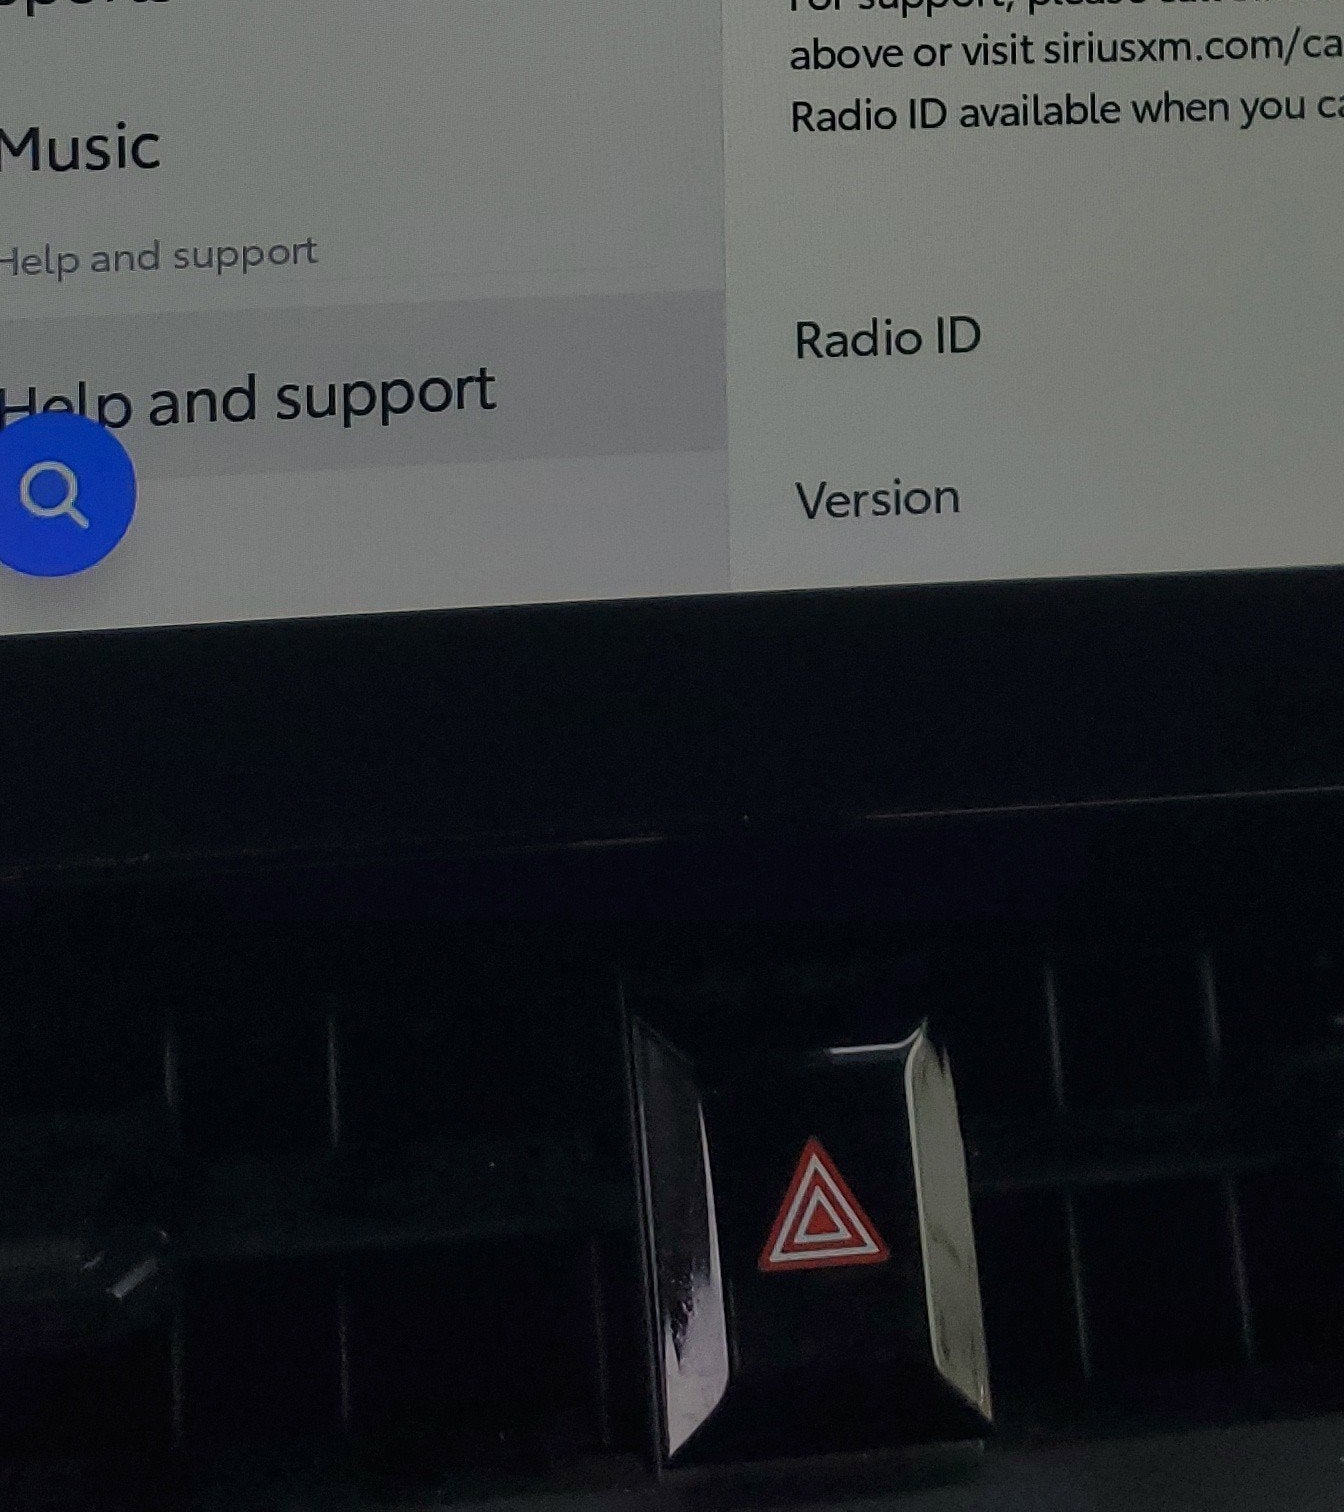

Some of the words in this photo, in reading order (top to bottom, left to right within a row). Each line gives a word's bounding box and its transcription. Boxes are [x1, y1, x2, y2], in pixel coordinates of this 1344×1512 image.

[791, 38, 903, 70] above
[914, 44, 952, 67] or
[962, 33, 1035, 65] visit
[793, 98, 897, 132] Radio
[910, 98, 947, 129] ID
[960, 93, 1120, 128] available
[1131, 91, 1229, 123] when
[1240, 97, 1305, 130] you
[91, 239, 160, 272] and
[174, 238, 318, 275] support
[797, 318, 922, 359] Radio
[938, 316, 981, 353] ID
[150, 373, 255, 426] and
[277, 368, 496, 428] support
[795, 478, 959, 519] Version
